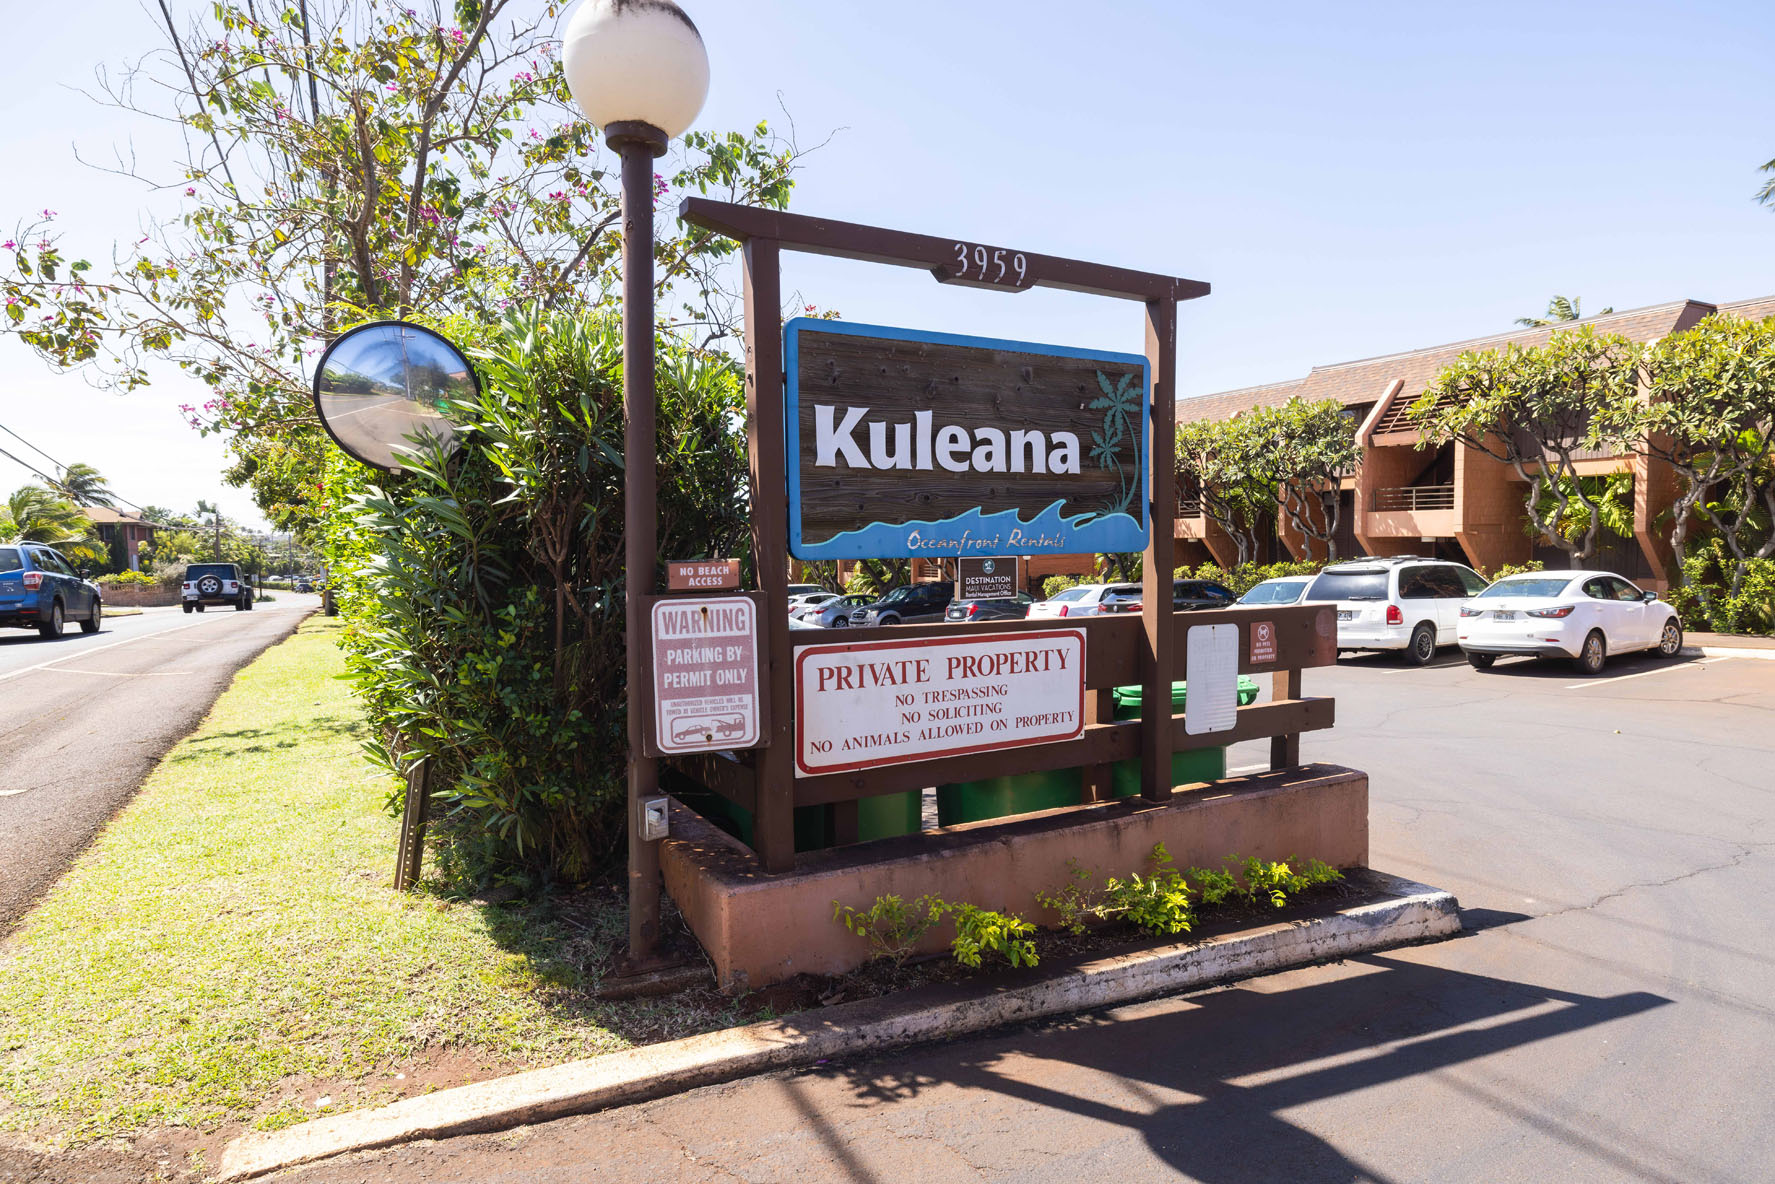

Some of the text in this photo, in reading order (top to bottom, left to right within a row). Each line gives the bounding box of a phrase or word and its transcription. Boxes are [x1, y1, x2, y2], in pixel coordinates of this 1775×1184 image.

[955, 243, 1027, 286] 3959
[813, 404, 1081, 475] Kuleana
[907, 528, 1066, 555] Oceanfront Rentals
[680, 566, 729, 576] NO BEACH
[688, 577, 723, 586] ACCESS
[965, 576, 1011, 585] DESTINATION
[981, 583, 1011, 591] VACATIONS
[662, 607, 746, 635] WARNING
[667, 646, 743, 665] PARKING BY
[664, 668, 748, 688] PERMIT ONLY
[817, 648, 1071, 692] PRIVATE PROPERTY
[895, 684, 1008, 707] NO TRESPASSING
[901, 702, 1002, 725] NO SOLICITING
[810, 710, 1075, 755] NO ANIMALS ALLOWED ON PROPERTY
